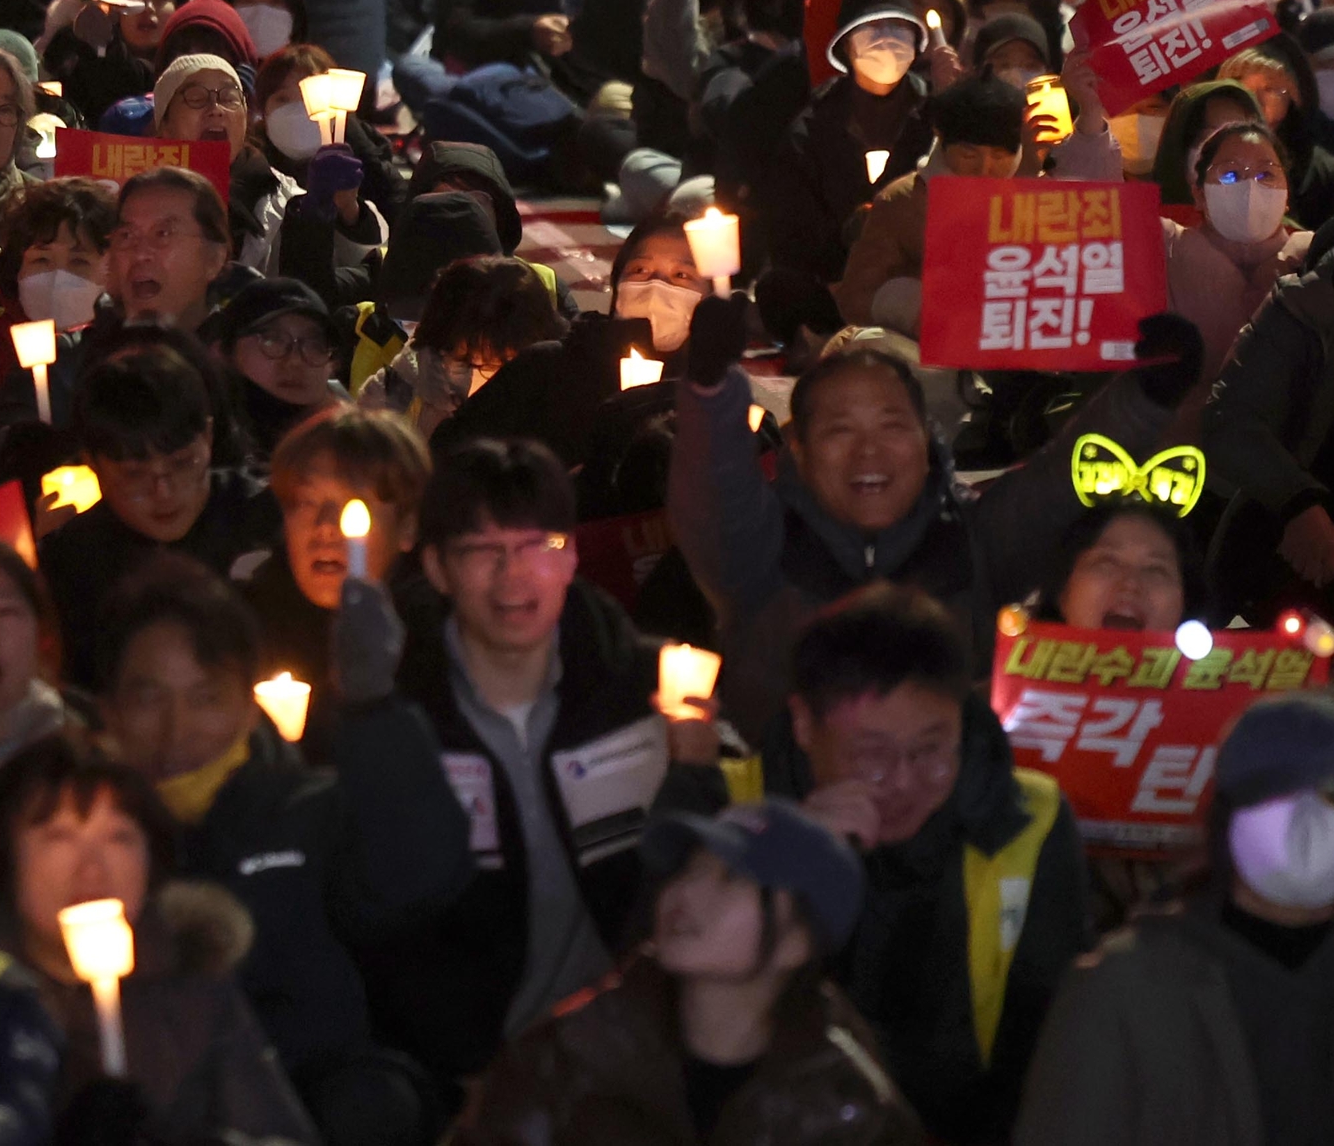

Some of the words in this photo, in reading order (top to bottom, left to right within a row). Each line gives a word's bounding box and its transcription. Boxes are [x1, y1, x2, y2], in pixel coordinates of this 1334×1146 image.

[1127, 19, 1214, 87] 퇴진!
[91, 145, 191, 178] 내란죄
[988, 189, 1122, 244] 내란죄
[982, 241, 1125, 299] 윤석열
[978, 297, 1093, 351] 퇴진!
[1003, 635, 1179, 689] 내란수괴
[1005, 689, 1164, 765] 즉각
